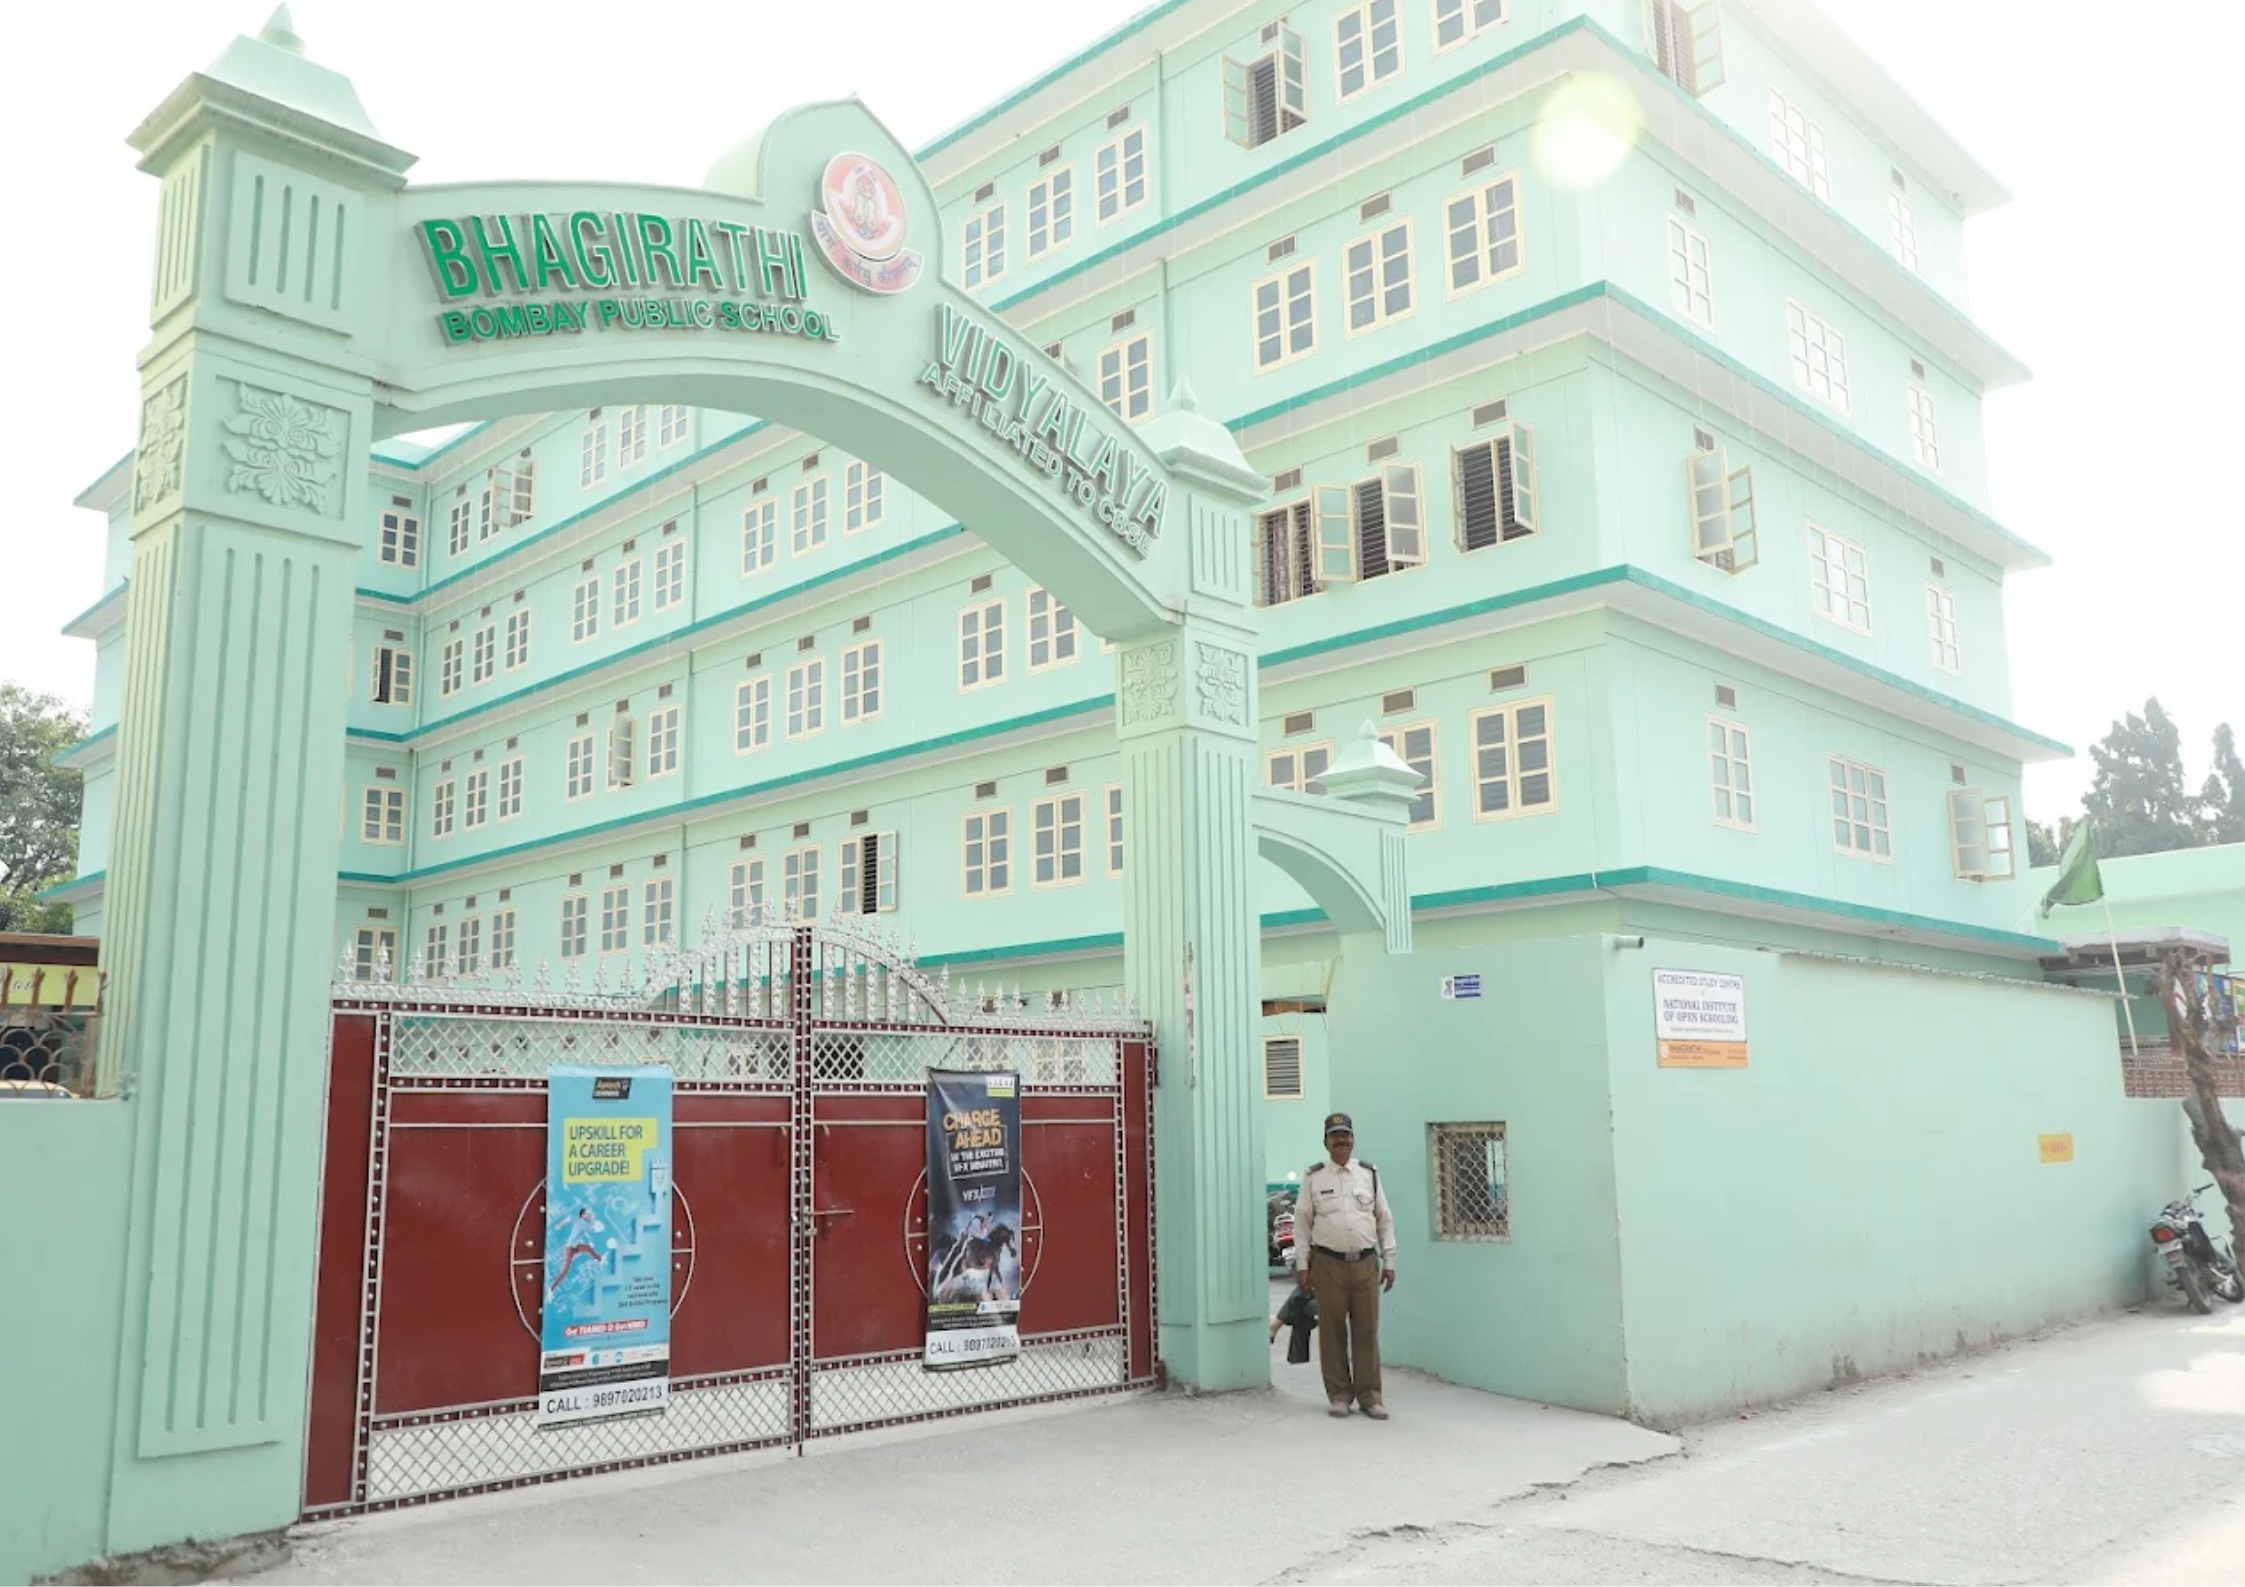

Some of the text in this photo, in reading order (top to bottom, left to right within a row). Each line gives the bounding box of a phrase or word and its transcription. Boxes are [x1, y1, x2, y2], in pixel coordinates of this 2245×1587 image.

[418, 210, 808, 304] BHAGIRATHI
[438, 298, 842, 345] BOMBAY PUBLIC SCHOOL
[939, 301, 1170, 540] VIDYALAYA
[920, 360, 1155, 560] AFFILIATED TO CBSE
[1663, 998, 1738, 1013] NATIONAL INSTITUTE
[1663, 1010, 1739, 1025] OF OPEN SCHOOLING
[943, 1108, 1001, 1133] CHARGE
[569, 1124, 644, 1140] UPSKILL FOR
[955, 1128, 1003, 1149] AHEAD
[568, 1142, 626, 1158] A CAREER
[568, 1160, 631, 1176] UPGRADE!
[930, 1340, 955, 1355] CALL
[547, 1397, 581, 1414] CALL
[593, 1385, 663, 1408] 9897020213
